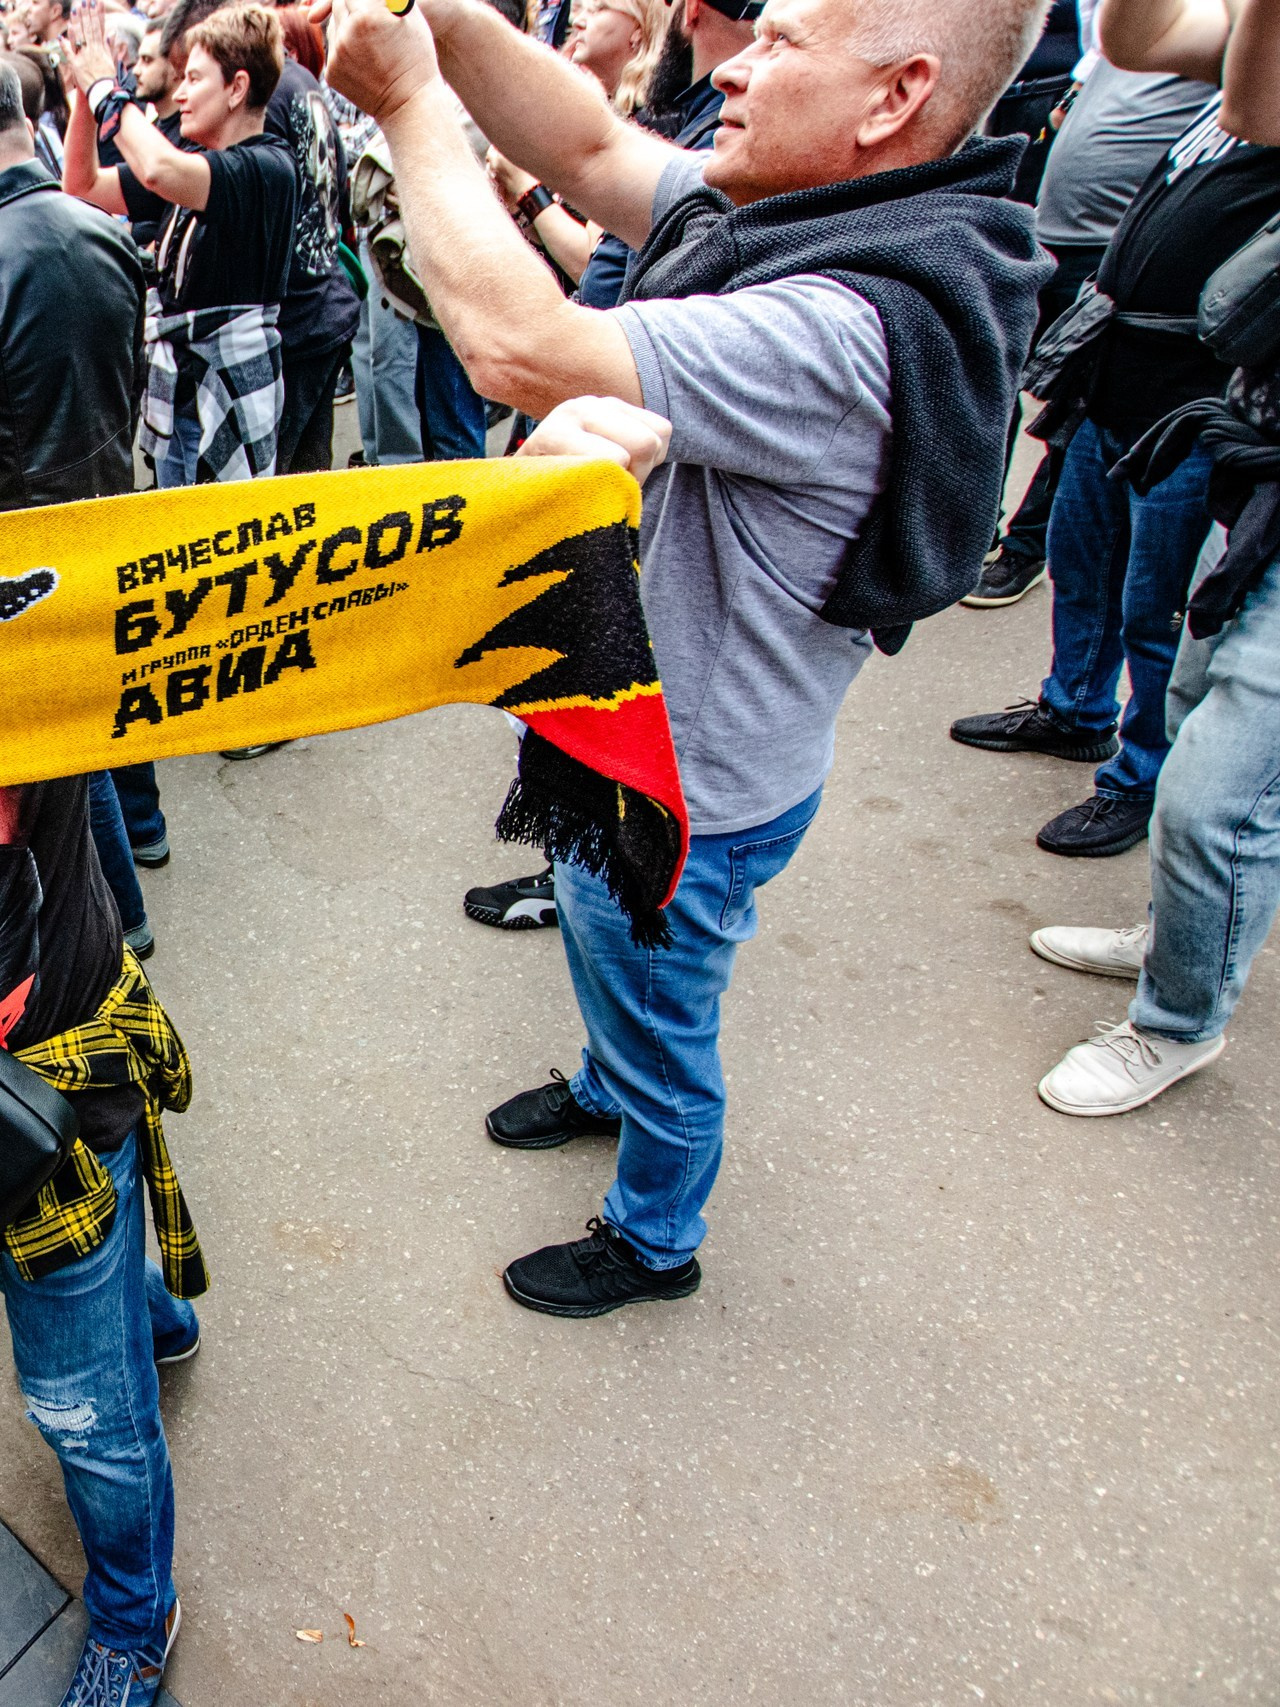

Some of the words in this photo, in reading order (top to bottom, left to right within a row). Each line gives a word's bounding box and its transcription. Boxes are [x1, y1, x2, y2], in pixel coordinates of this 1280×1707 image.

[115, 494, 467, 655] БУТУСОВ
[116, 502, 316, 594] ВЯЧЕСЛАВ
[111, 628, 316, 738] АВИА
[141, 645, 211, 678] ГРУППА
